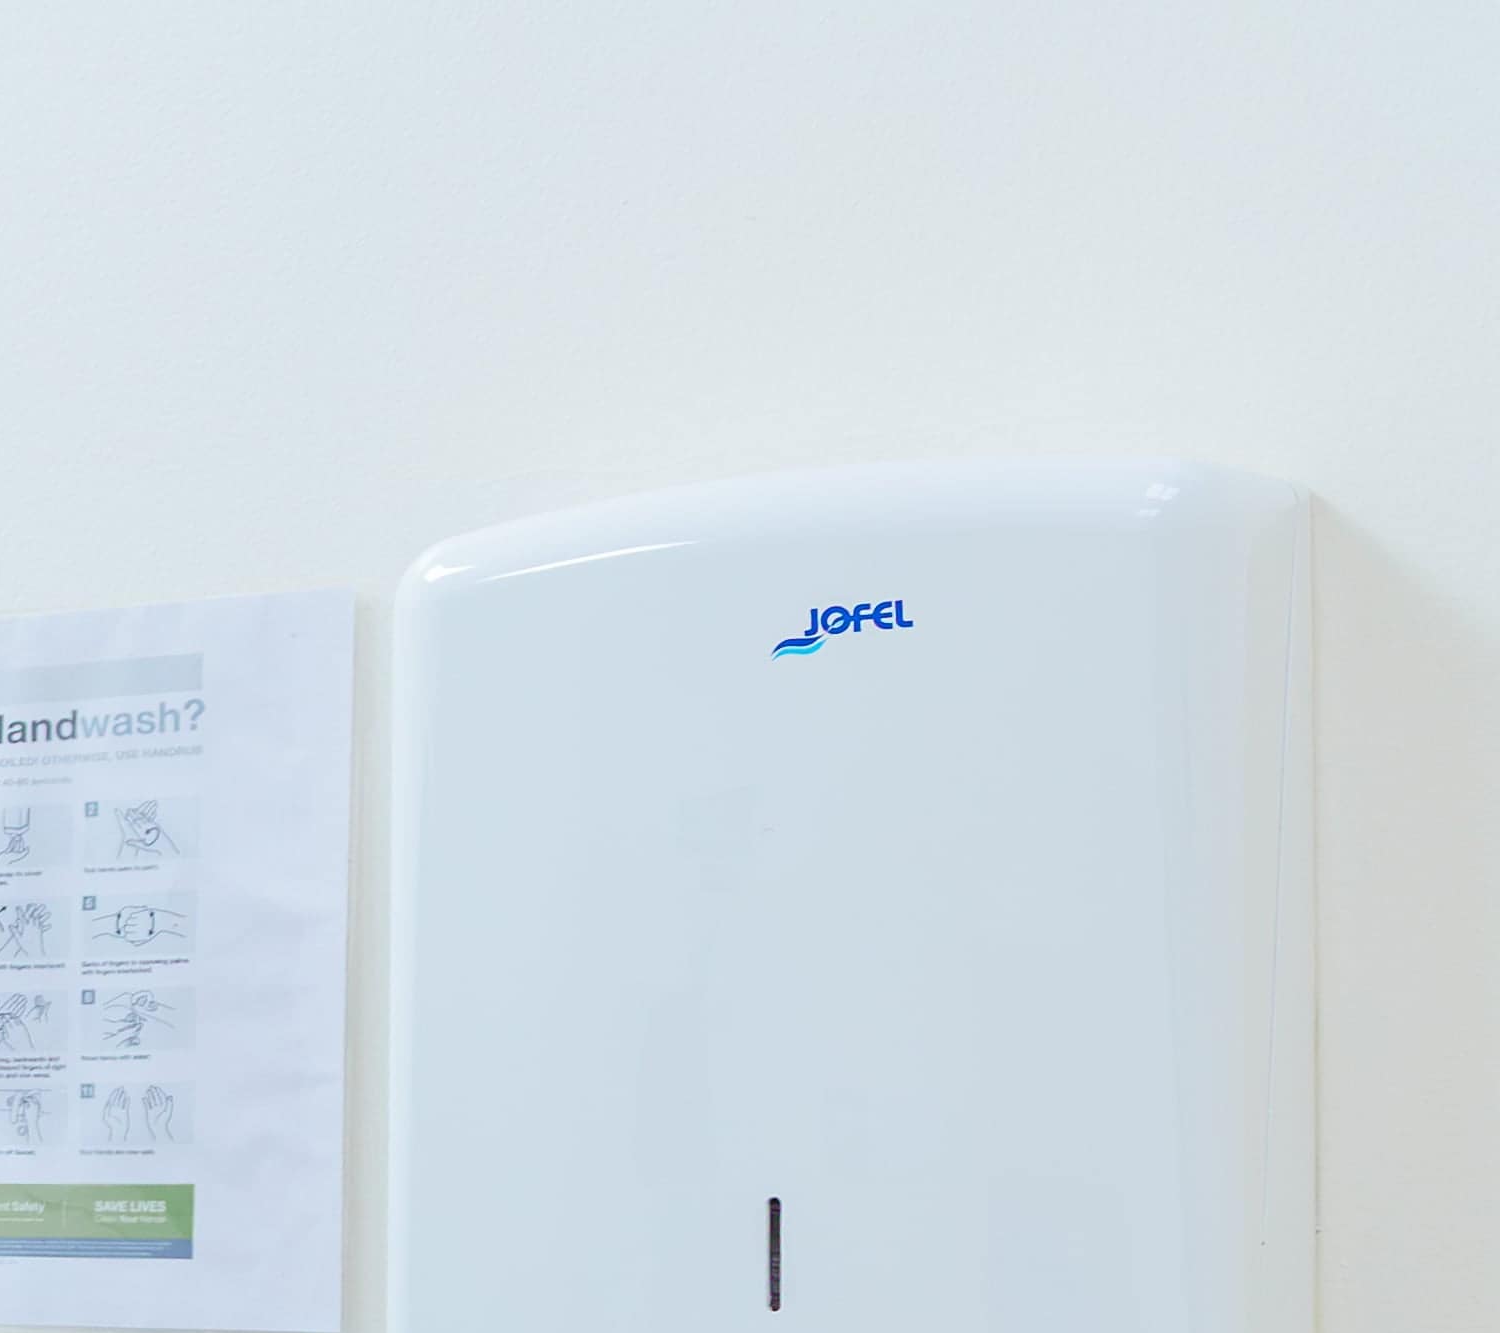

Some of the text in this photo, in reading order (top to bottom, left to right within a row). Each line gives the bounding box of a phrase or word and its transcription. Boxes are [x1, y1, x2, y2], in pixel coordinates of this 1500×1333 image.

[804, 600, 914, 637] JOFEL
[12, 1200, 46, 1215] Safety
[94, 1200, 167, 1213] SAVE LIVES
